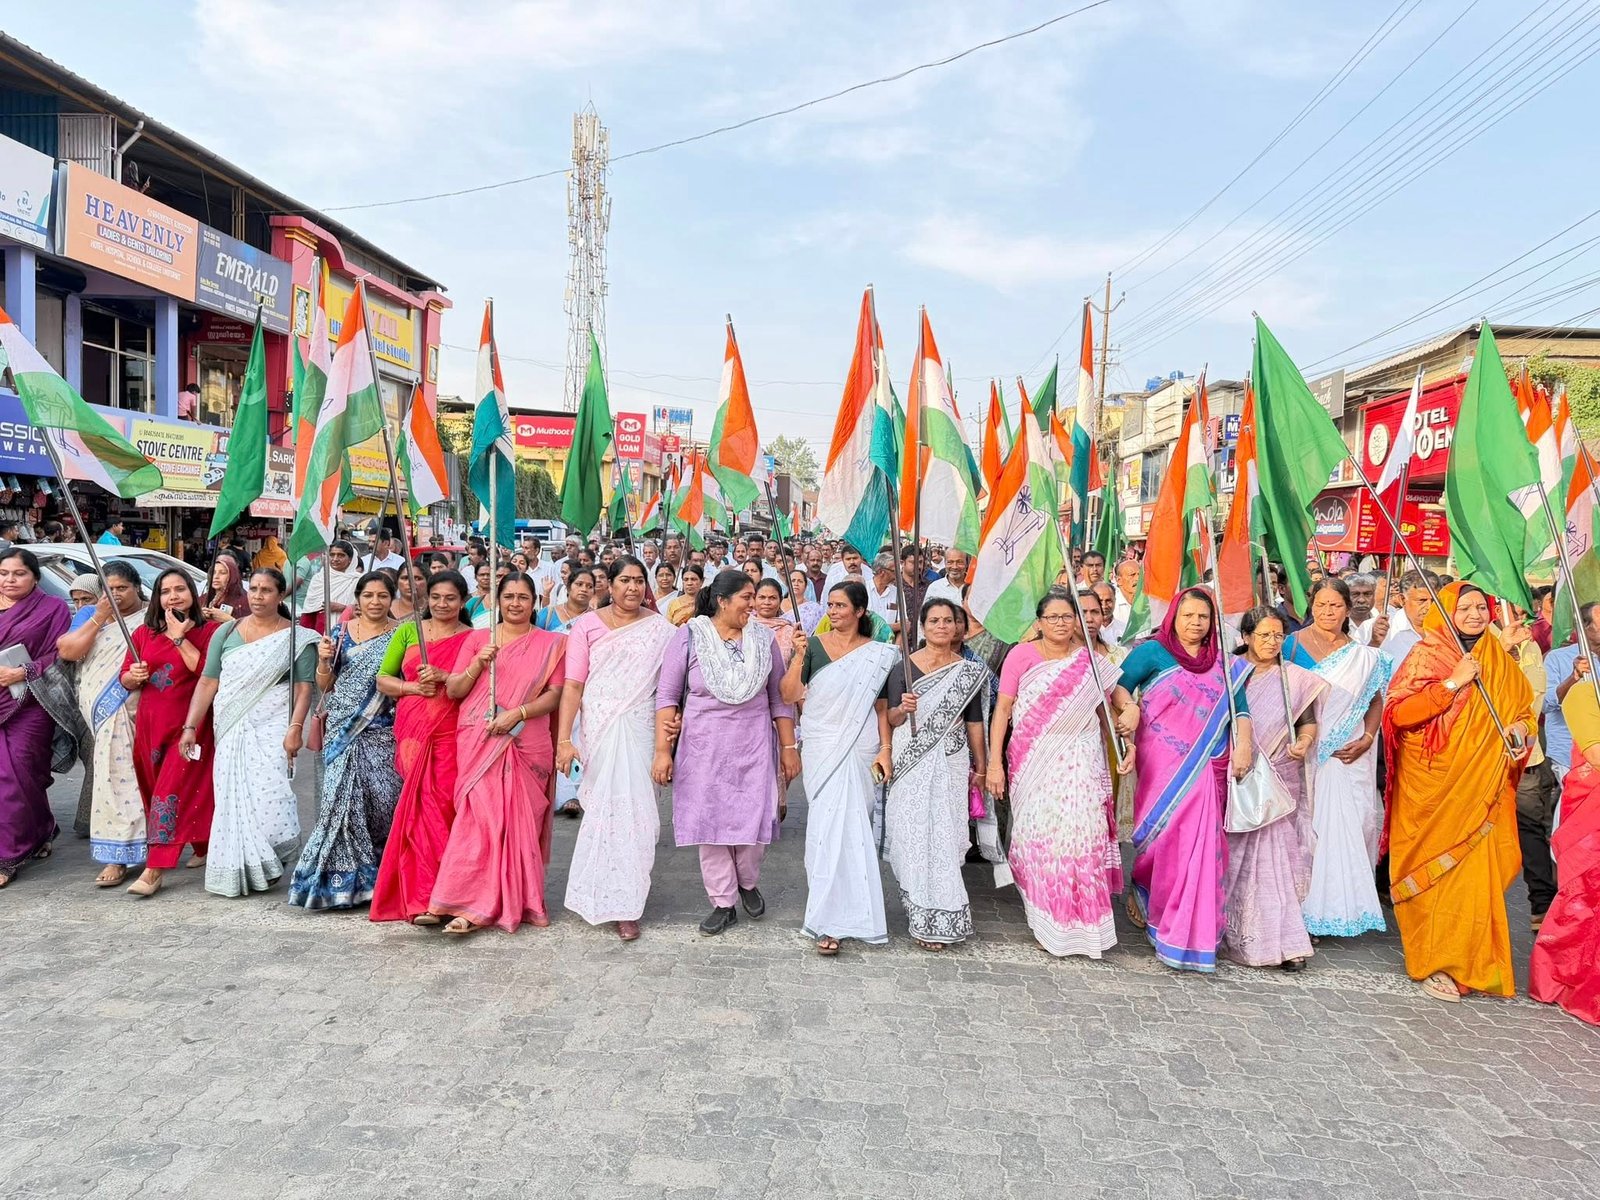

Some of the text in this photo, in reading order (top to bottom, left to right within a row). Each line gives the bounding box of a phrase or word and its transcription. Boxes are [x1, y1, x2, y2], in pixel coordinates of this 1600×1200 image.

[85, 193, 185, 253] HEAVENLY
[99, 226, 121, 243] LADIES
[121, 234, 127, 246] &
[127, 237, 145, 252] GENTS
[215, 252, 279, 297] EMERALD
[253, 290, 276, 309] TRVELS
[1412, 406, 1450, 431] OTEL
[536, 427, 570, 436] Muthoot
[619, 433, 641, 443] GOLD
[3, 440, 47, 456] WEAR
[136, 439, 204, 461] STOVE CENTRE
[618, 444, 640, 453] LOAN
